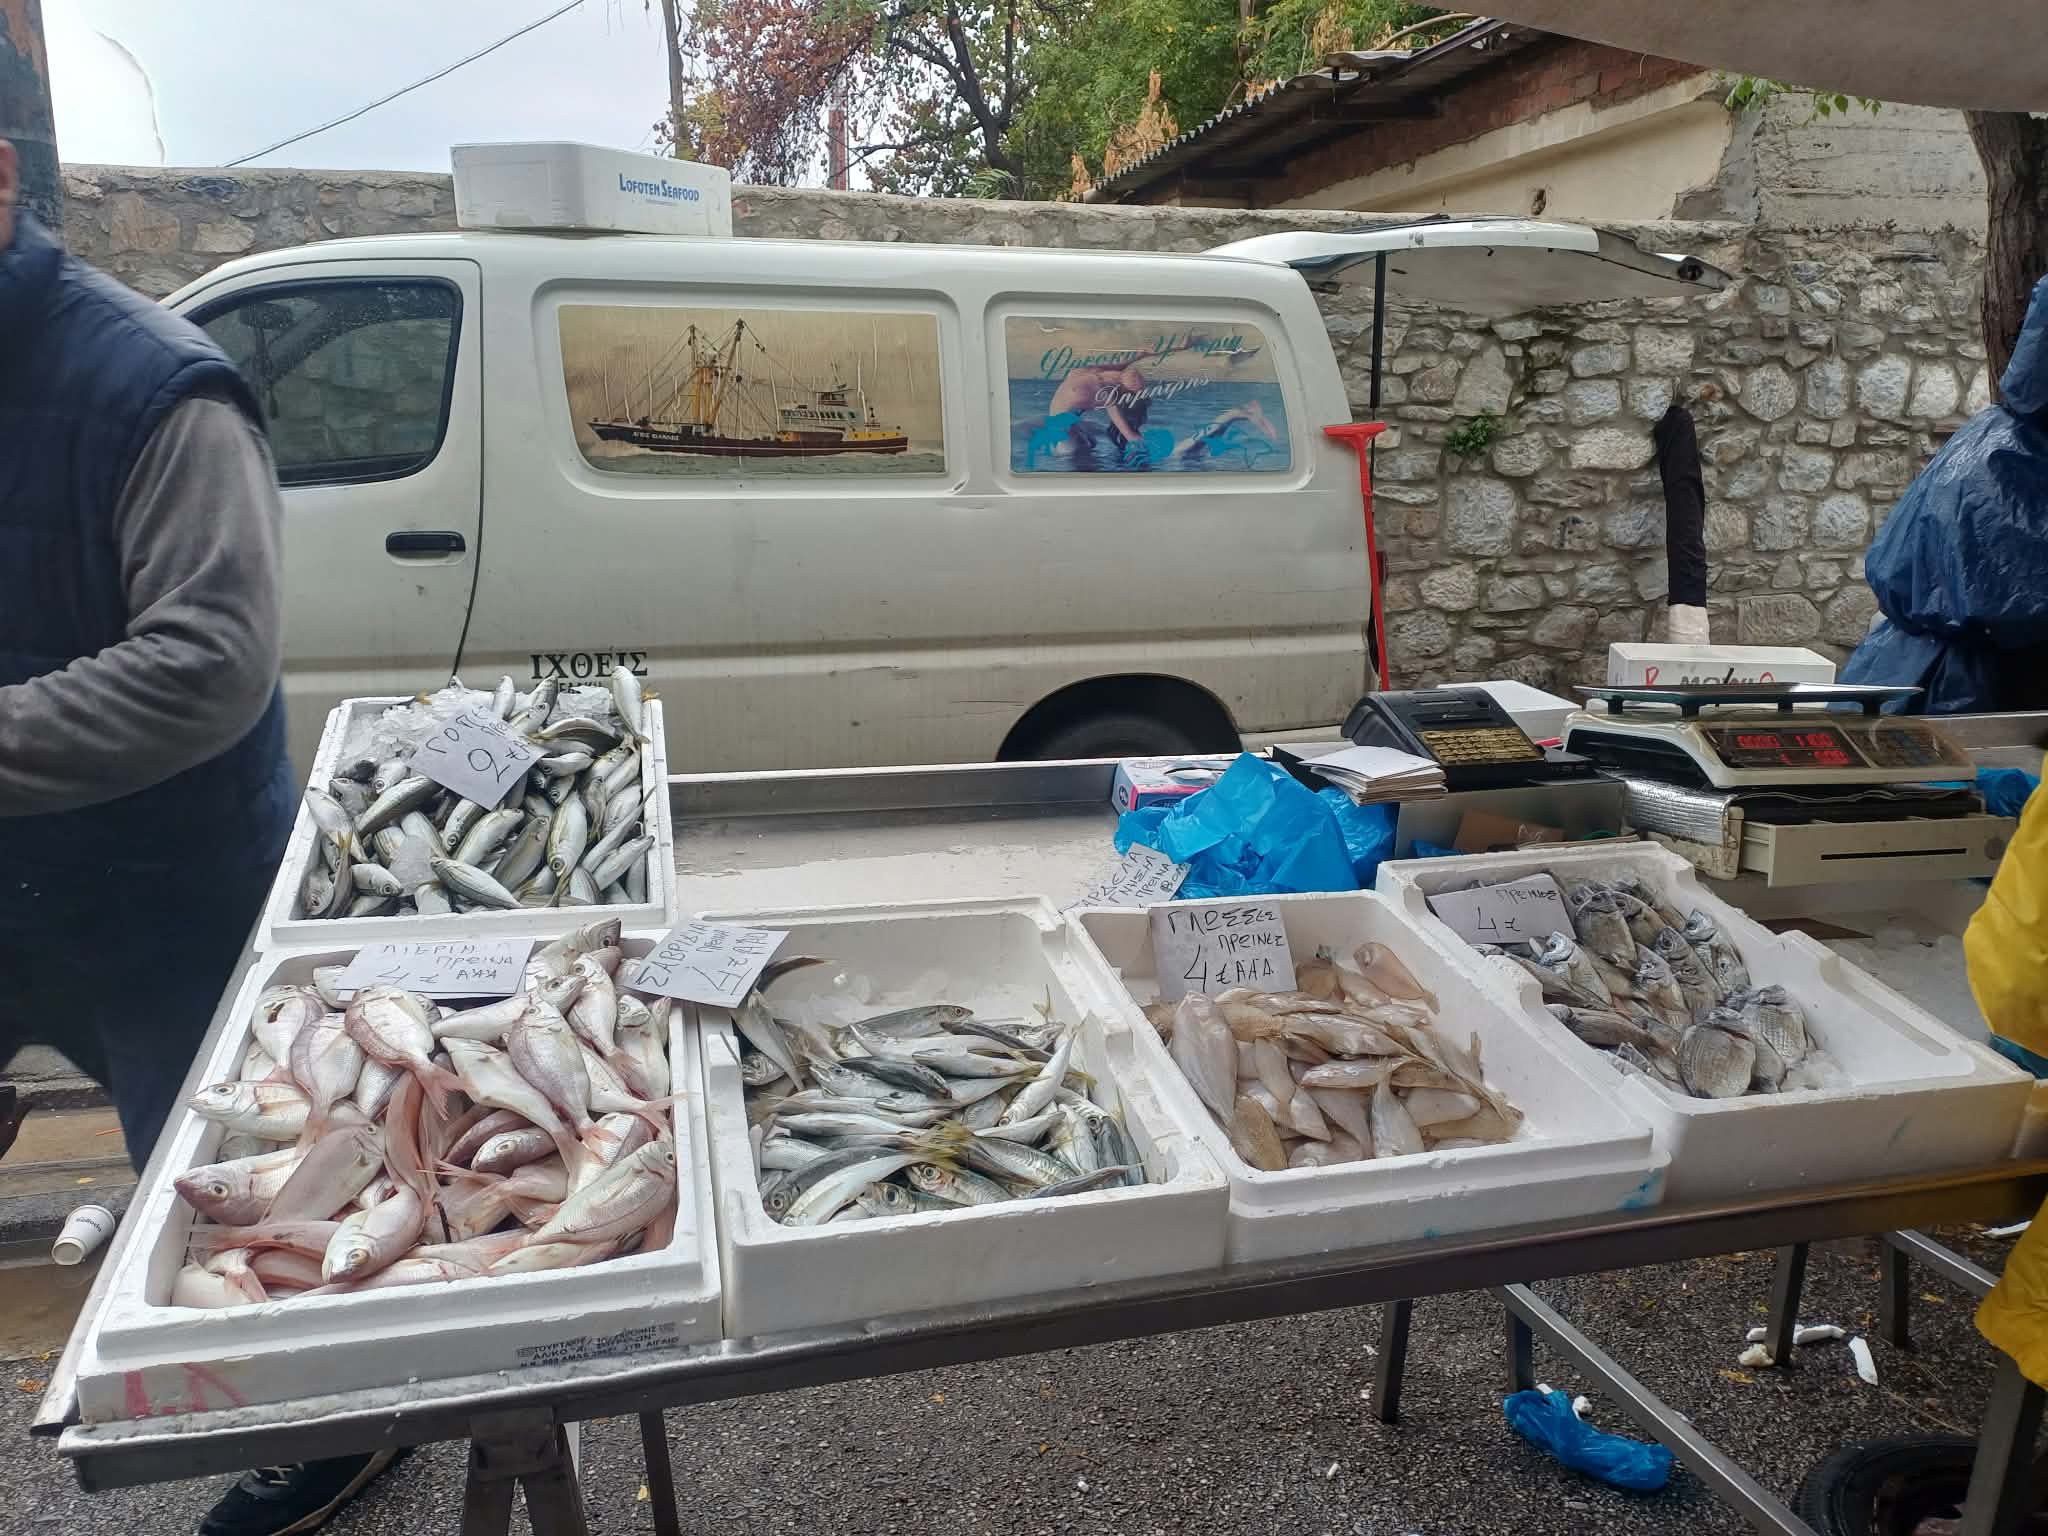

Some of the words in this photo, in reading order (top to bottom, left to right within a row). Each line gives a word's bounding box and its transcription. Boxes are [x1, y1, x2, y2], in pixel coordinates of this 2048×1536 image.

[619, 172, 660, 197] LOFOTEN
[661, 179, 700, 202] SEAFOOD
[1183, 944, 1207, 993] 4
